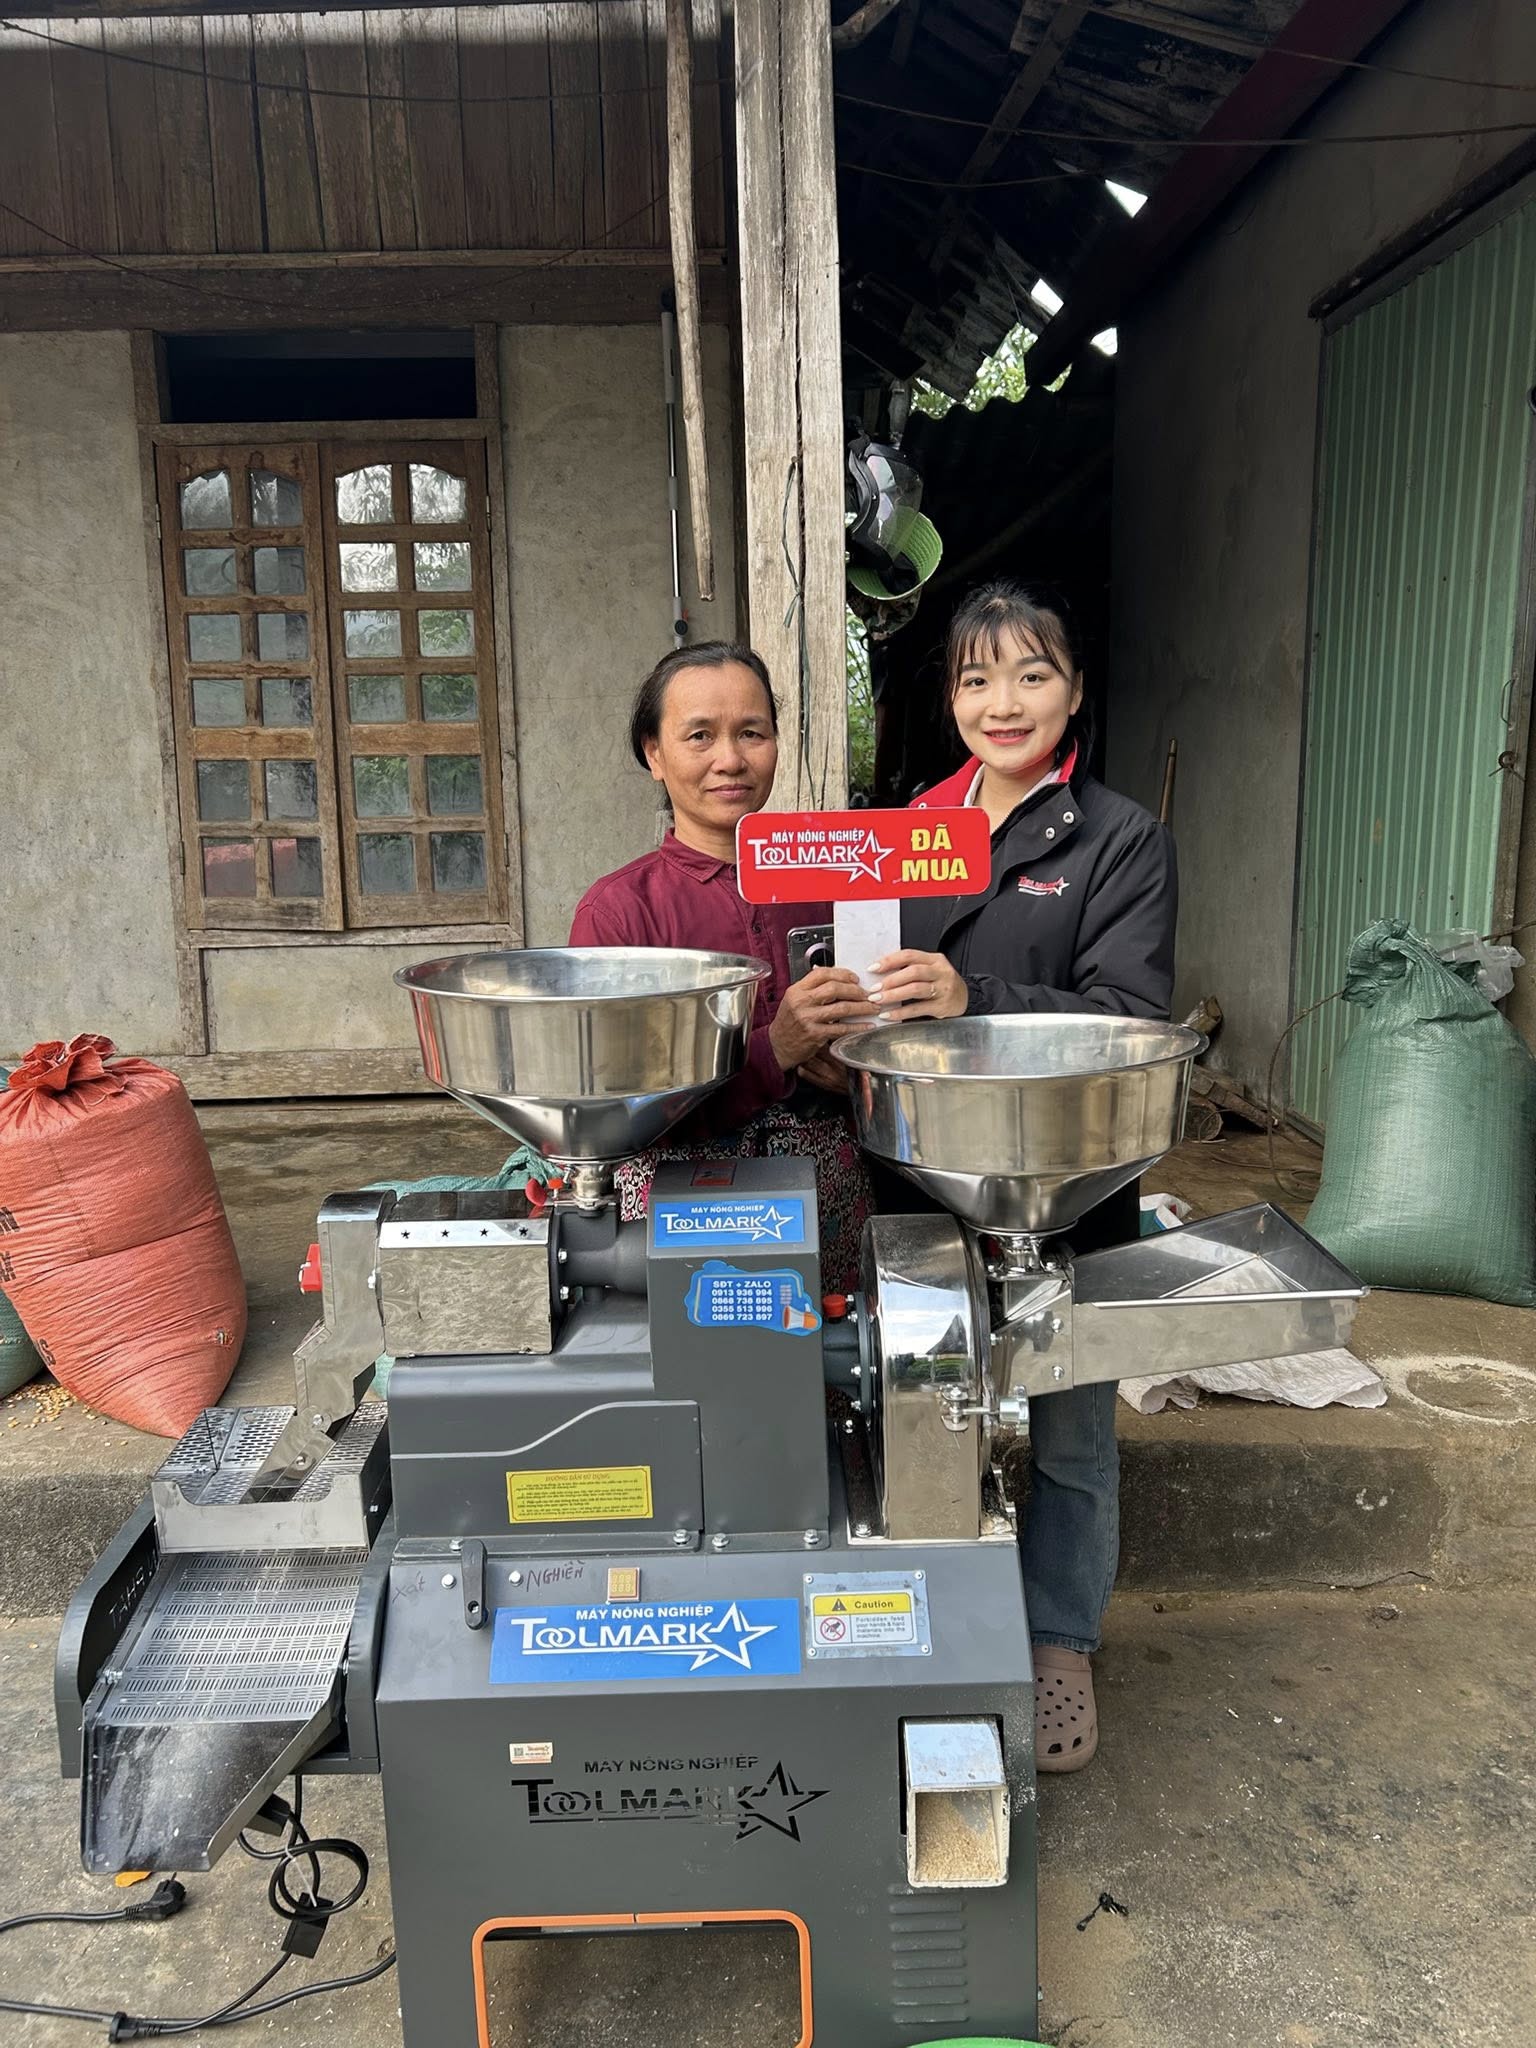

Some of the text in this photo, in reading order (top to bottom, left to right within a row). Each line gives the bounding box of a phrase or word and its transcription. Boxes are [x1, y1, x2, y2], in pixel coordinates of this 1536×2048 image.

[772, 827, 865, 845] MÁY NÔNG NGHIỆP
[911, 823, 953, 852] ĐÃ
[747, 838, 861, 865] TOOLMARK
[902, 858, 969, 882] MUA
[660, 1213, 762, 1231] TOOLMARK
[744, 1280, 771, 1288] ZALO
[576, 1603, 714, 1621] MÁY NÔNG NGHIỆP
[854, 1600, 894, 1609] Caution
[511, 1617, 712, 1649] TOOLMARK
